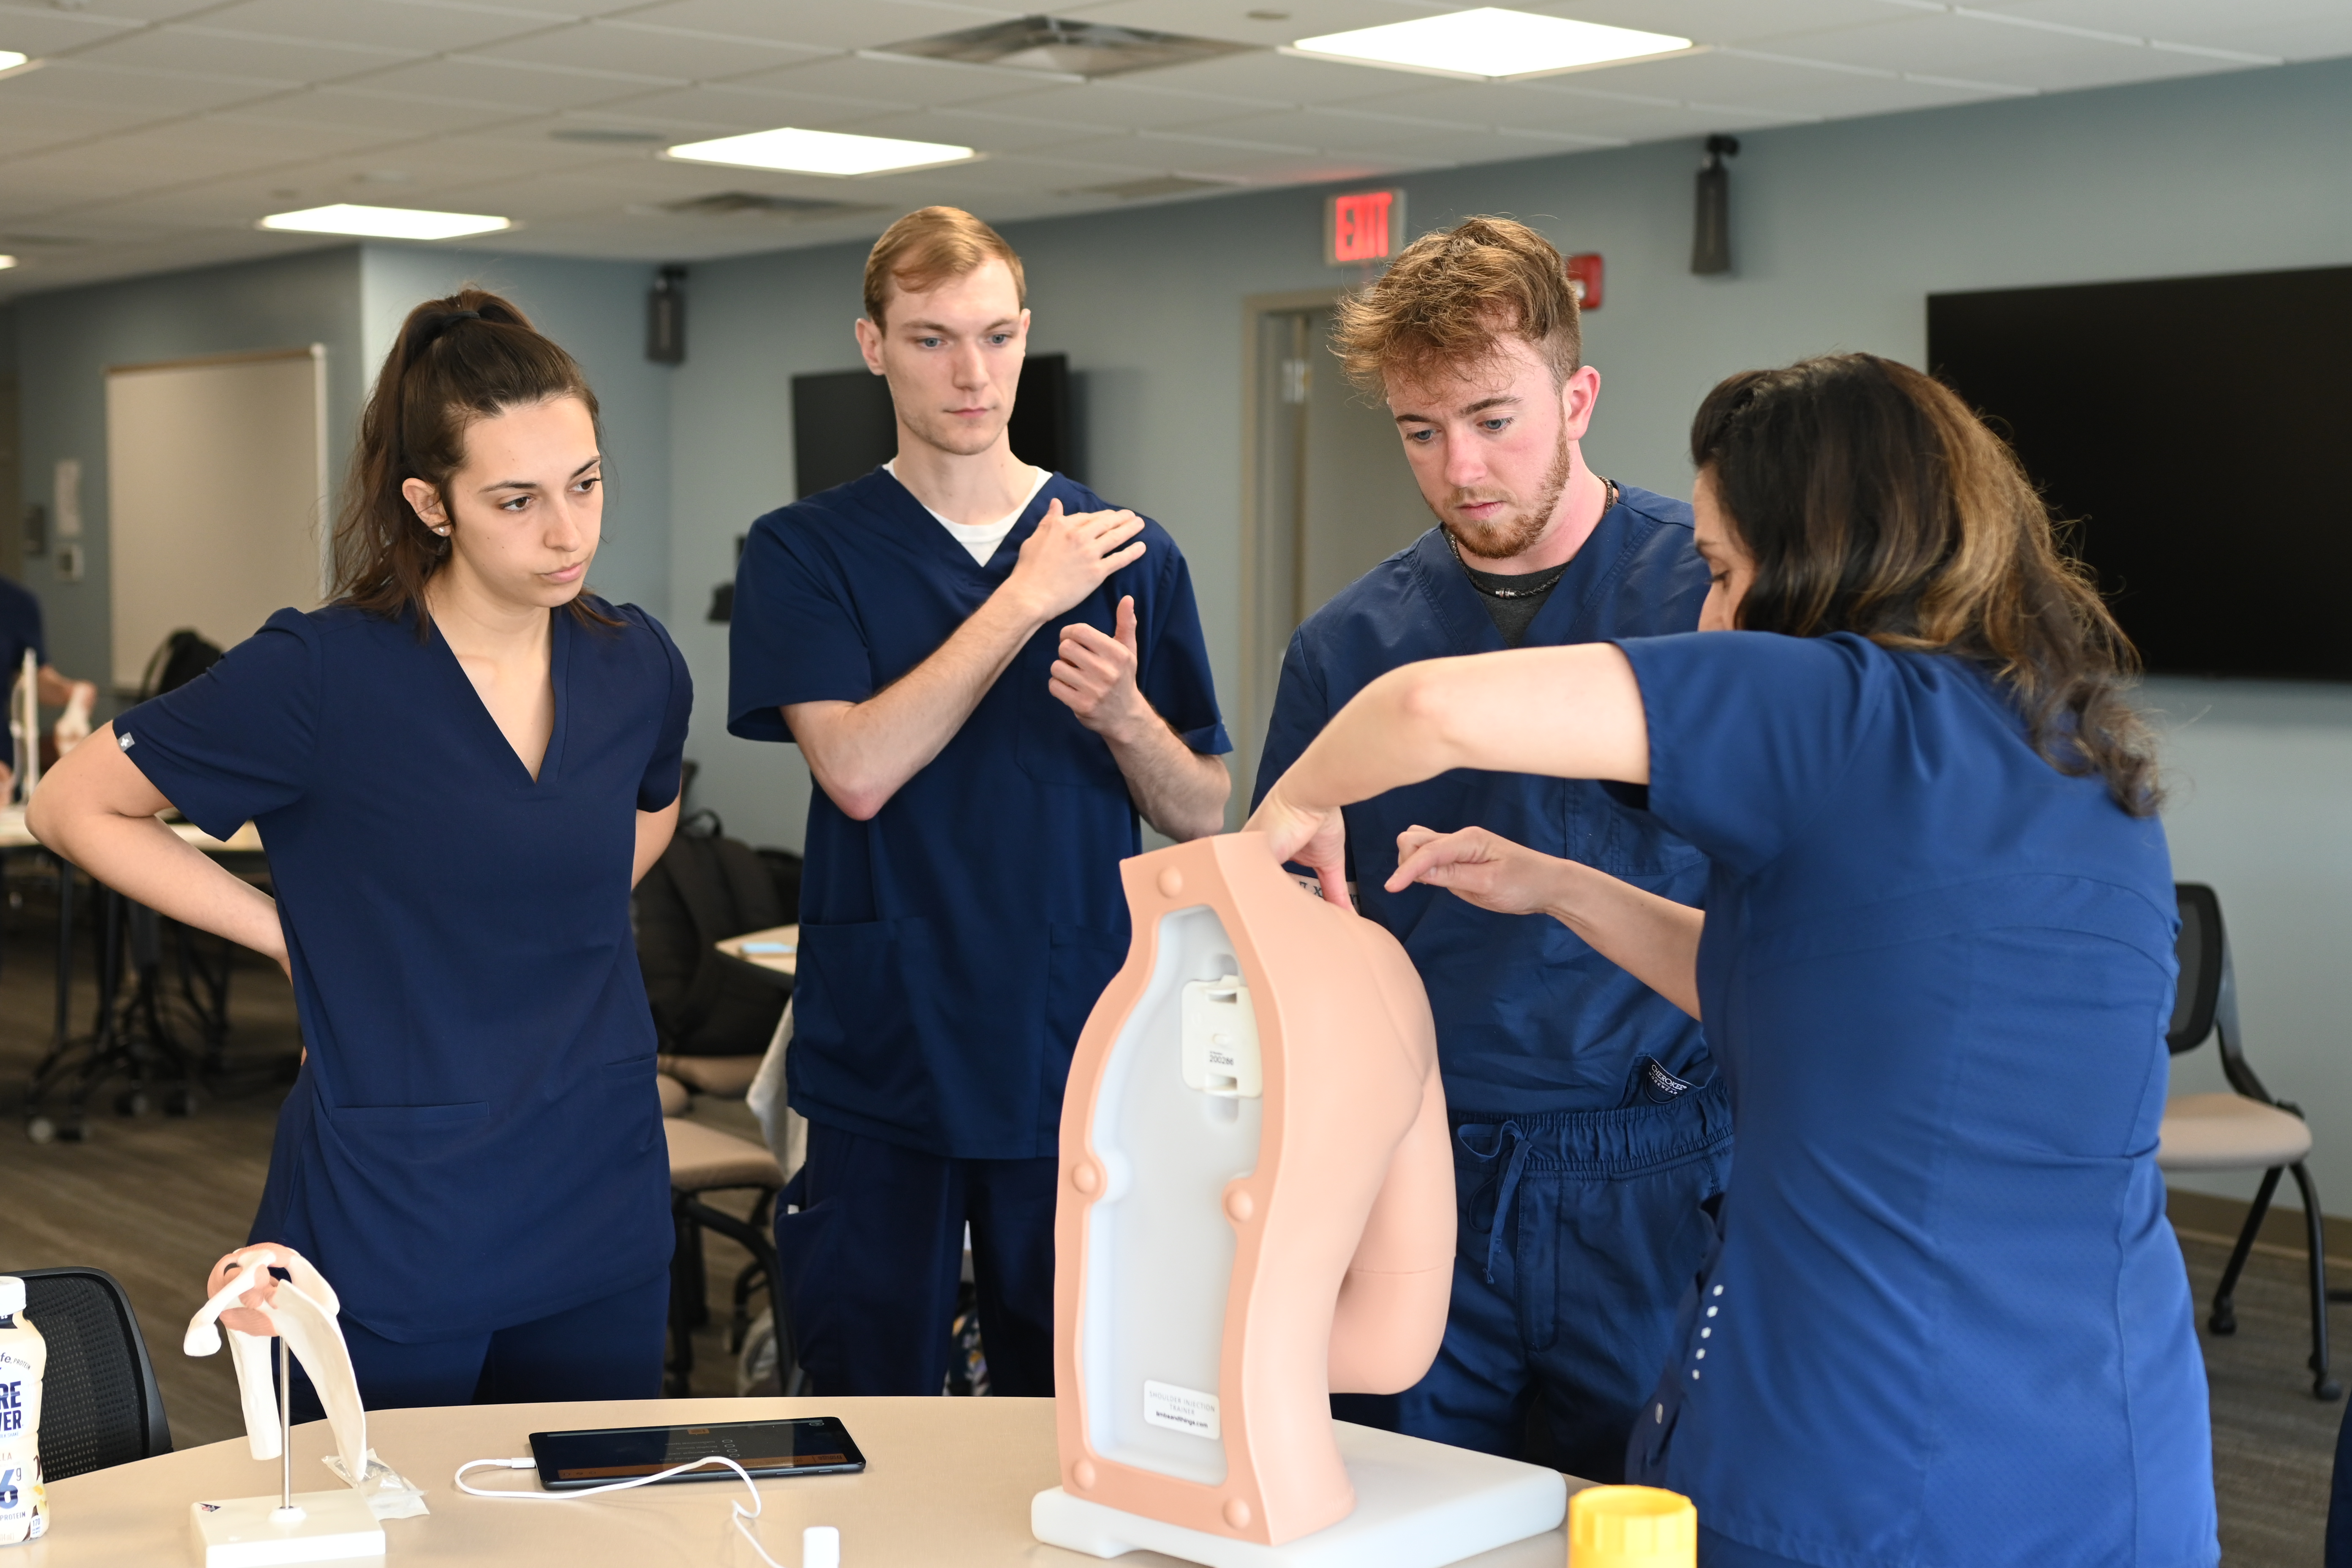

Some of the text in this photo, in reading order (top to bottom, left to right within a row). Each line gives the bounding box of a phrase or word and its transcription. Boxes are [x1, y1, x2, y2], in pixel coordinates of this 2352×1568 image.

[1336, 192, 1392, 261] EXIT
[1649, 1071, 1677, 1095] WORKWEAR
[1652, 1064, 1685, 1090] CHEROKEE
[13, 1358, 31, 1370] PROTEIN
[1149, 1391, 1215, 1412] SHOULDER INJECTION
[1170, 1404, 1195, 1415] TRAINER
[0, 1410, 21, 1431] ER
[0, 1511, 25, 1521] PROTEIN
